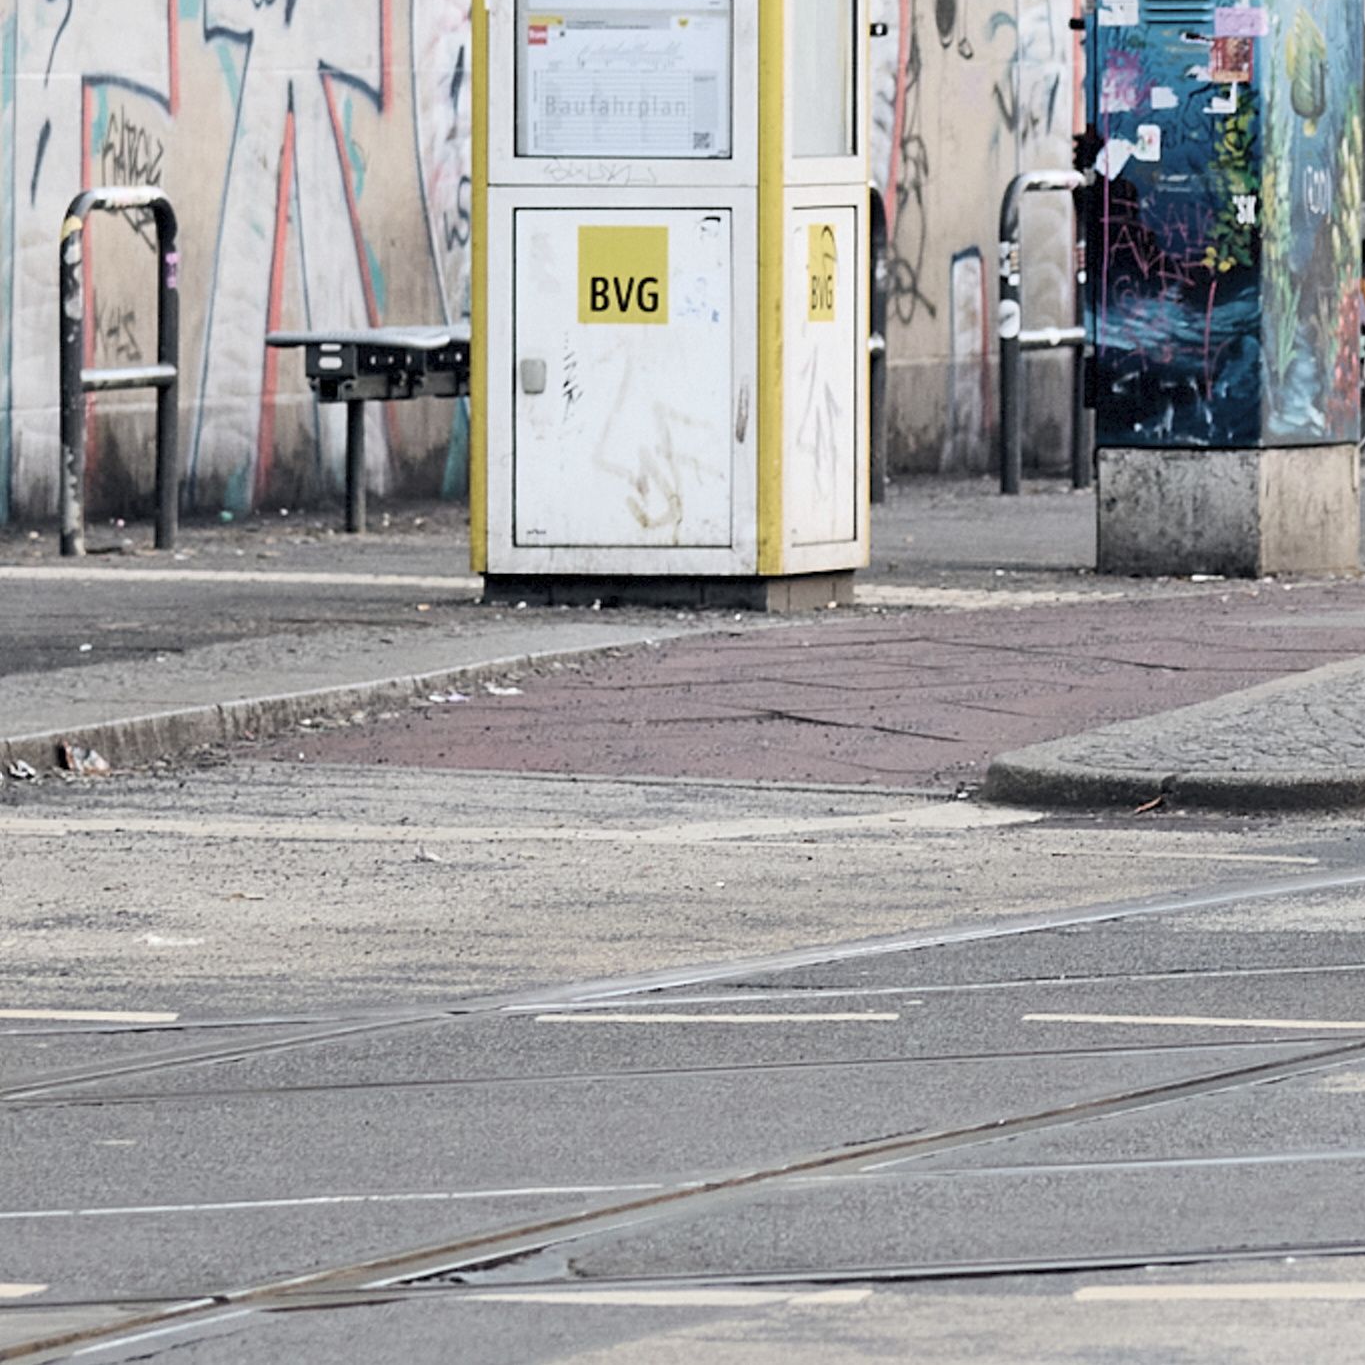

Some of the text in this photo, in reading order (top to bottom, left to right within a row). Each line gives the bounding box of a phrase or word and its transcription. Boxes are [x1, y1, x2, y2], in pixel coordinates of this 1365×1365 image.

[544, 94, 687, 119] Baufahrplan
[589, 276, 660, 314] BVG
[810, 274, 834, 311] BVG
